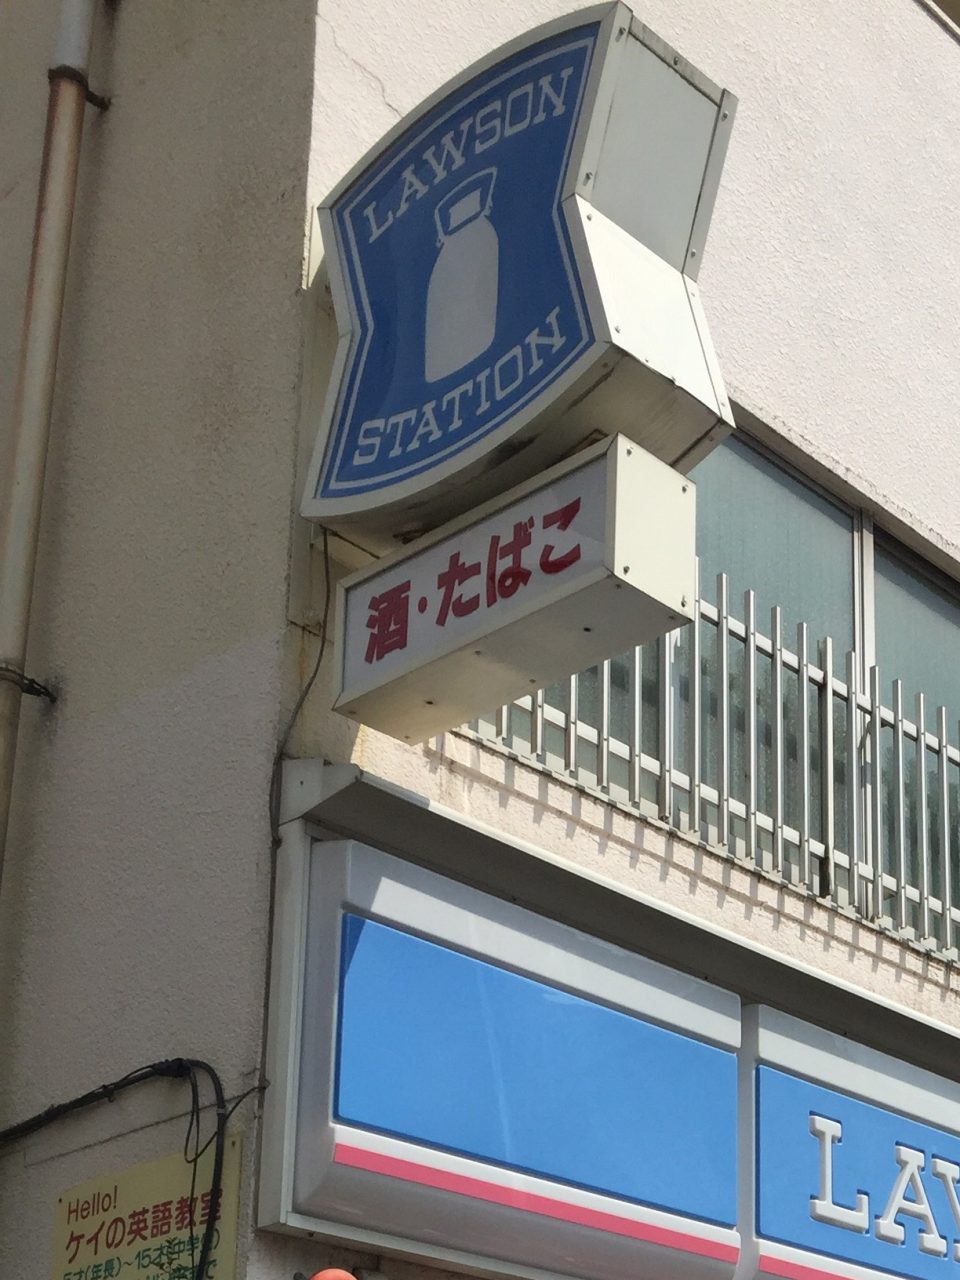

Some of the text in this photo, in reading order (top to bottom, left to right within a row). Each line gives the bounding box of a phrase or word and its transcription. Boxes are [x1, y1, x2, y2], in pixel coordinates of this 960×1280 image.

[363, 66, 575, 244] LAWSON
[352, 306, 569, 467] STATION
[363, 497, 583, 665] 酒・たばこ
[67, 1185, 119, 1225] Hello!
